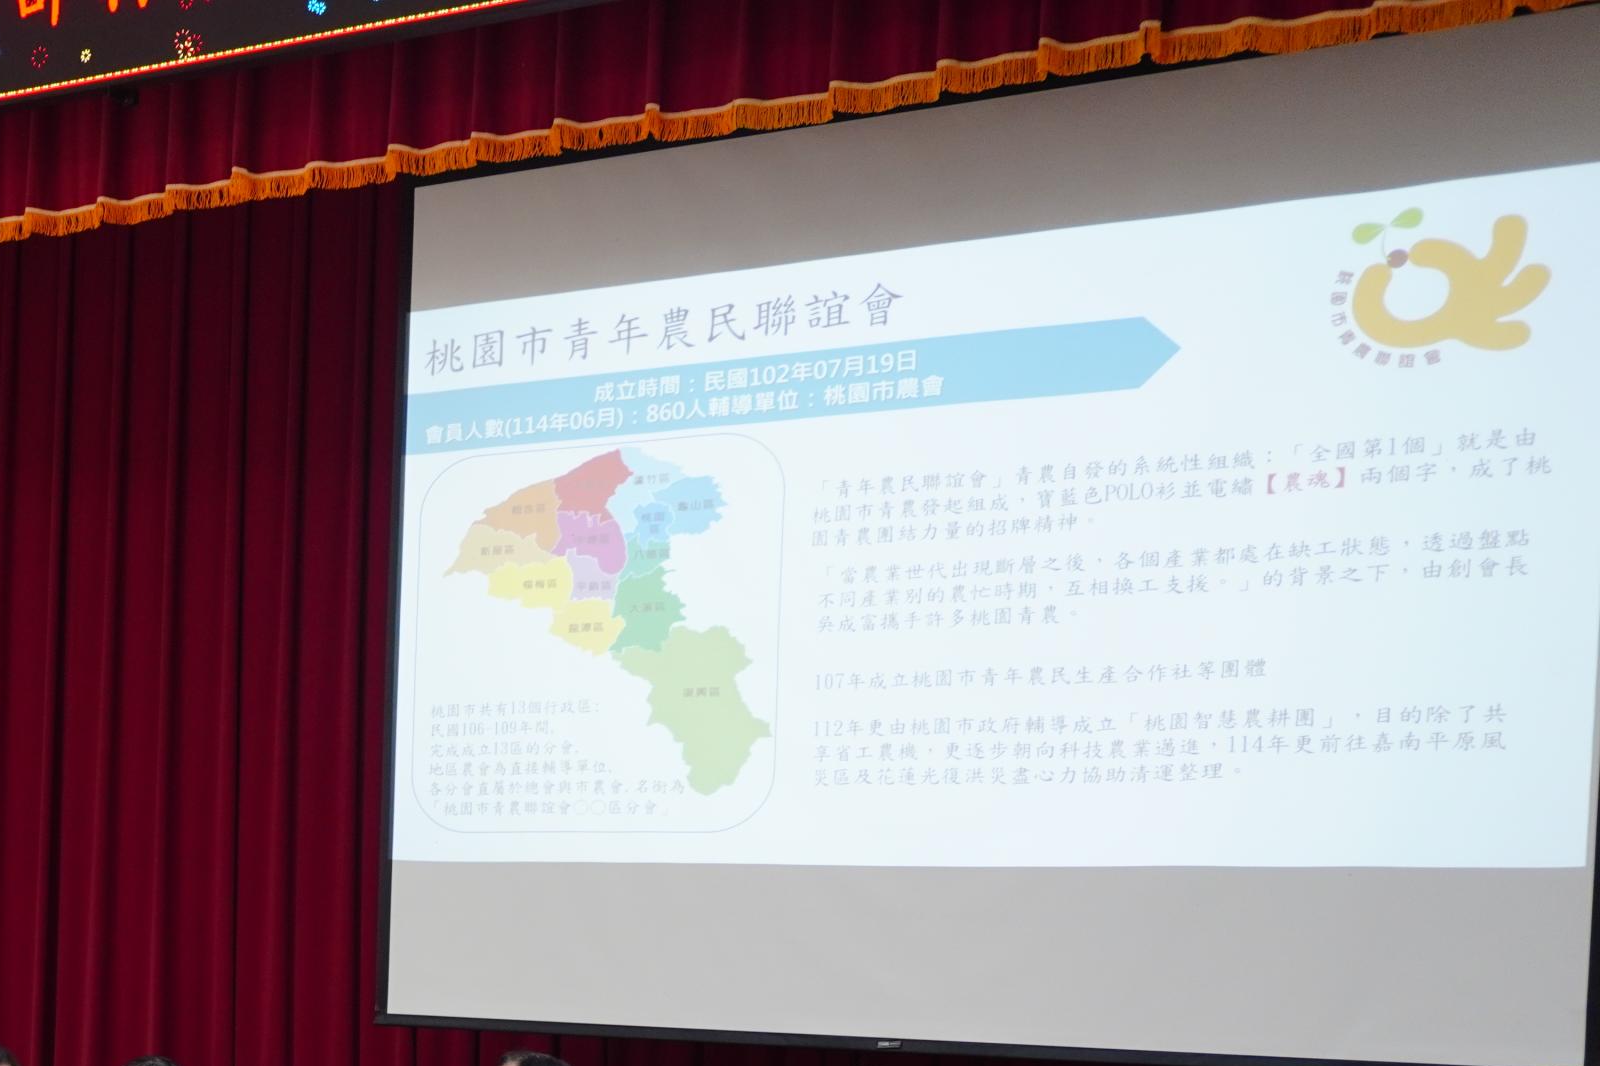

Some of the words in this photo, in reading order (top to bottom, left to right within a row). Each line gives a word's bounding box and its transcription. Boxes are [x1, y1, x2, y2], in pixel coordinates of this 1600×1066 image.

[426, 282, 904, 376] 桃園市青年農民聯誼會
